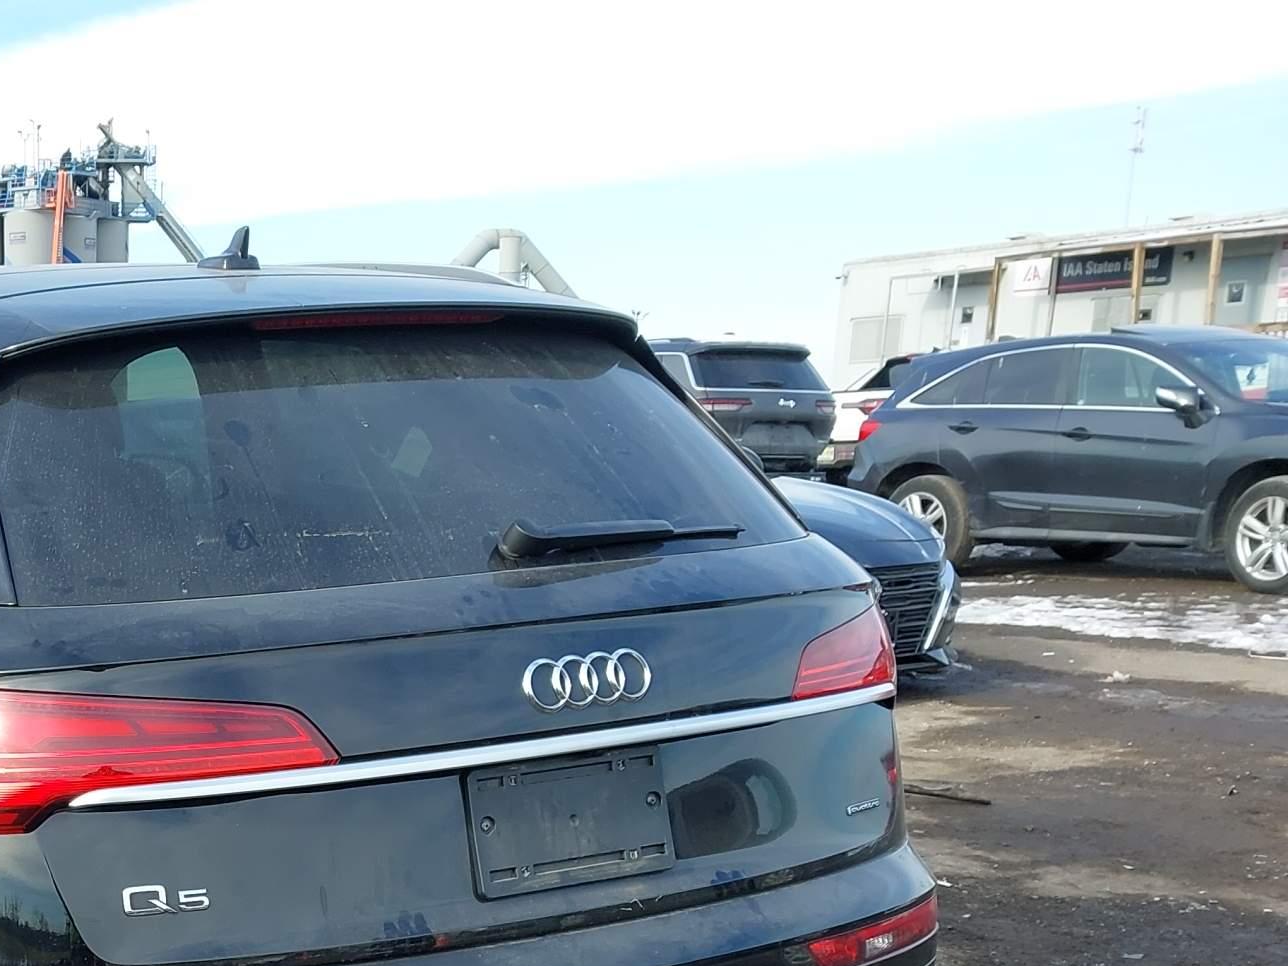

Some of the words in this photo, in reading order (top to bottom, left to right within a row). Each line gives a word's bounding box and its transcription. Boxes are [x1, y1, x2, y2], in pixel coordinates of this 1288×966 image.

[1063, 261, 1083, 277] IAA
[1085, 259, 1120, 275] Staten
[1123, 253, 1160, 271] Isnd
[122, 885, 210, 916] Q5
